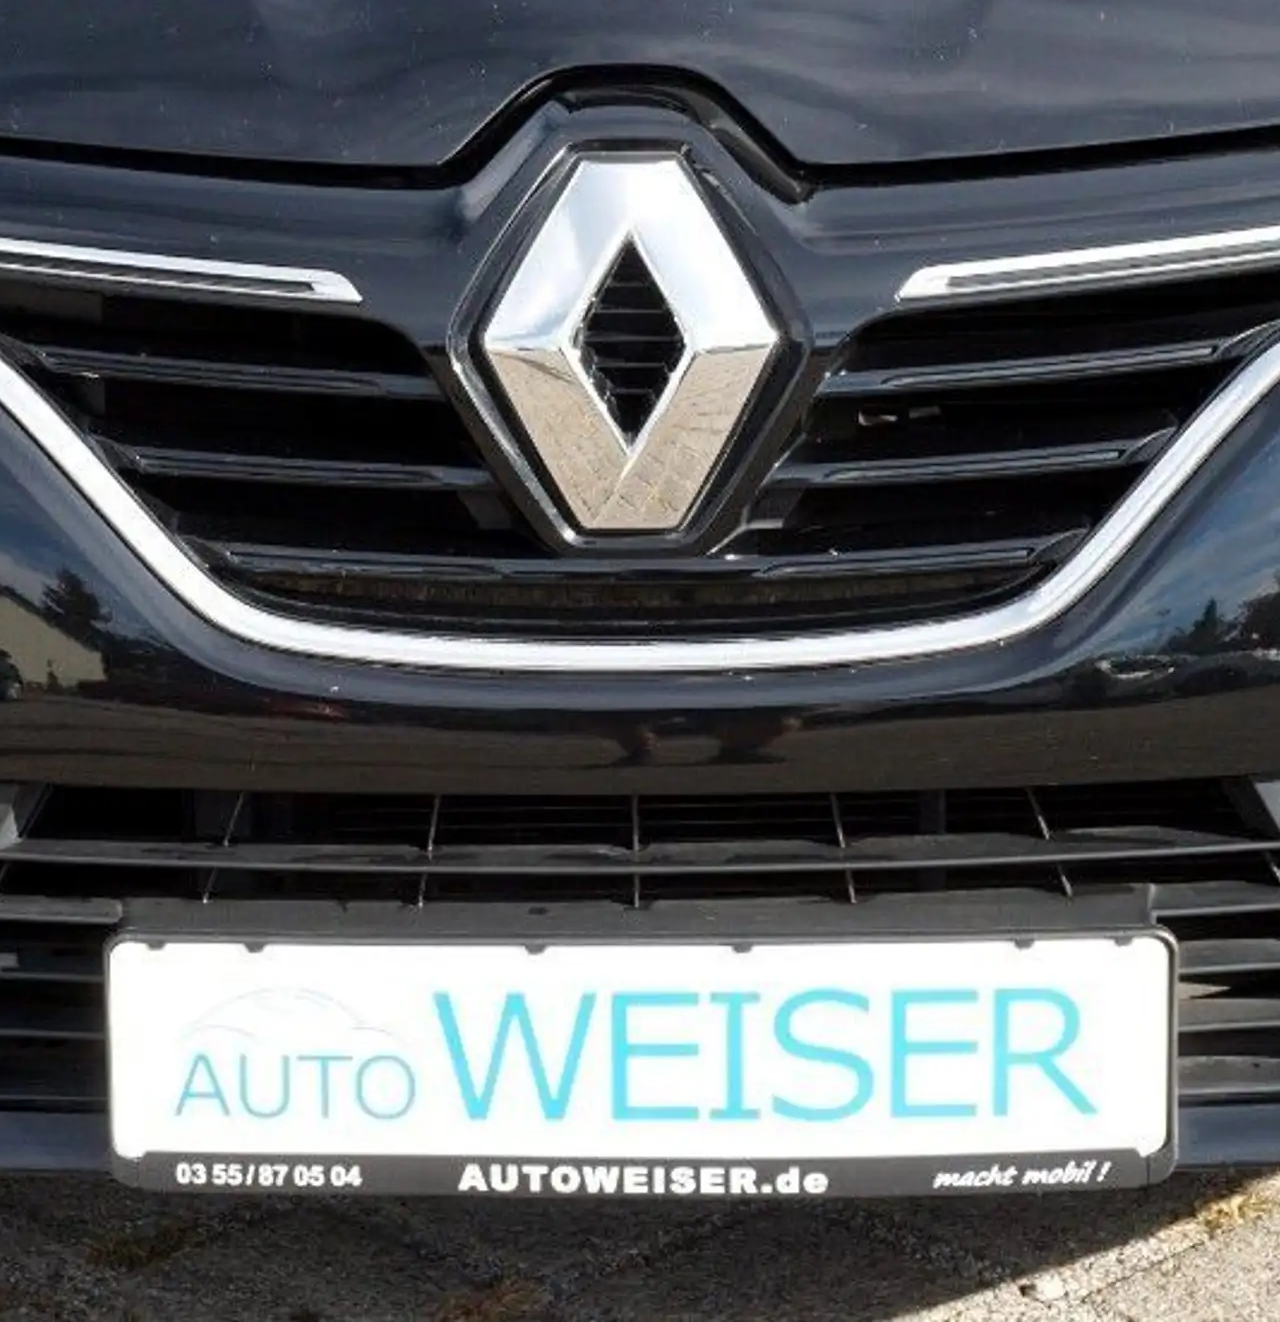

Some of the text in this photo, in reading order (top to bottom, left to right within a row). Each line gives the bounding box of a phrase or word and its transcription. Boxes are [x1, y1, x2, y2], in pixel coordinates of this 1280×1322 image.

[174, 986, 1099, 1124] AUTO WEISER
[175, 1161, 208, 1186] 03
[292, 1163, 326, 1188] 05
[329, 1163, 363, 1188] 04
[457, 1162, 830, 1195] AUTOWEISER.de
[932, 1162, 1016, 1189] macht
